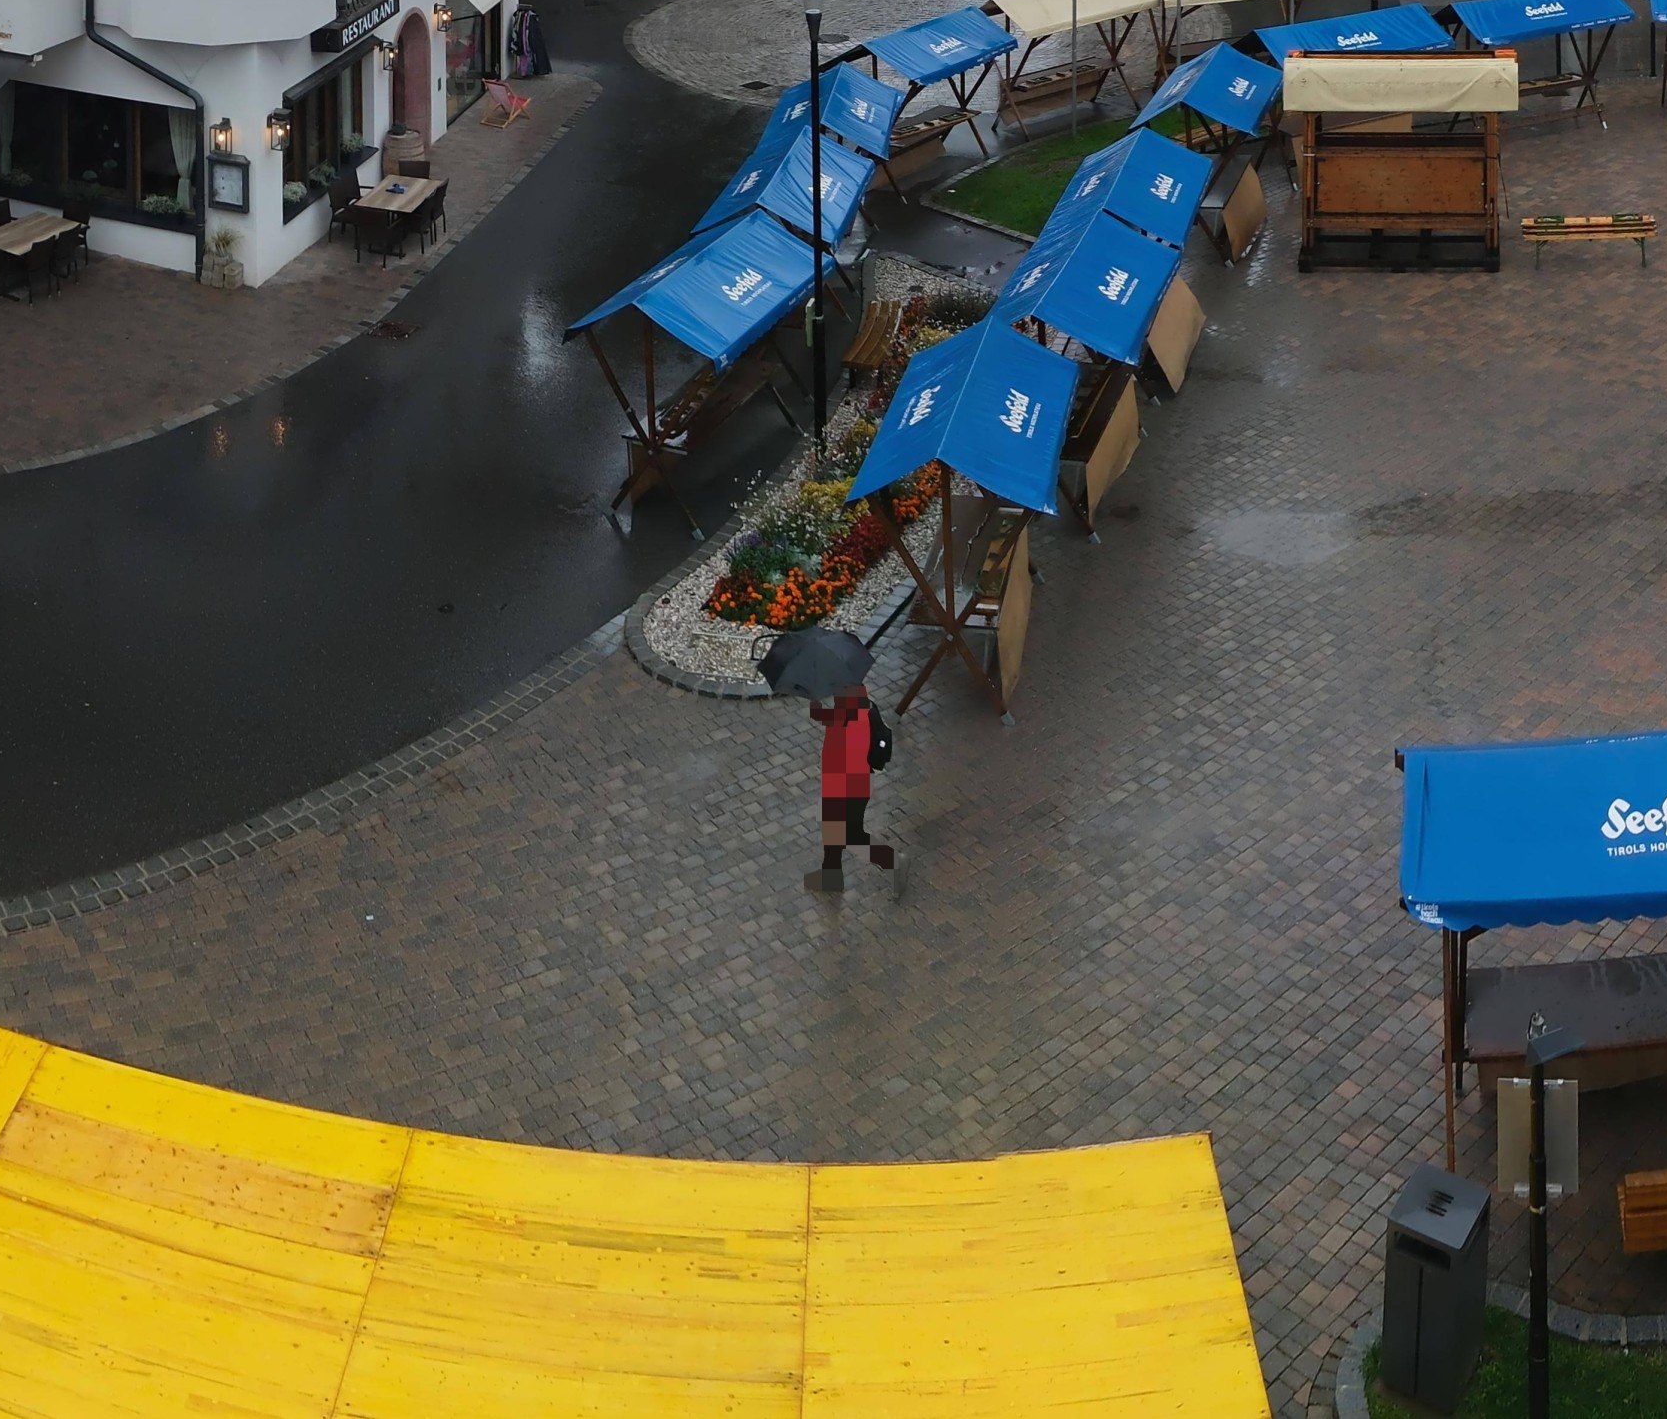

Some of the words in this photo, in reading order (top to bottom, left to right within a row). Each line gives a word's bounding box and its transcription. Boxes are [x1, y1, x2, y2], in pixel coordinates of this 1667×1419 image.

[1525, 2, 1565, 17] Seefeld
[1337, 32, 1379, 47] Seefeld
[721, 267, 763, 301] Seefeld
[1098, 266, 1129, 301] Seefeld
[999, 387, 1029, 433] Seefeld
[1607, 843, 1646, 857] TIROLS
